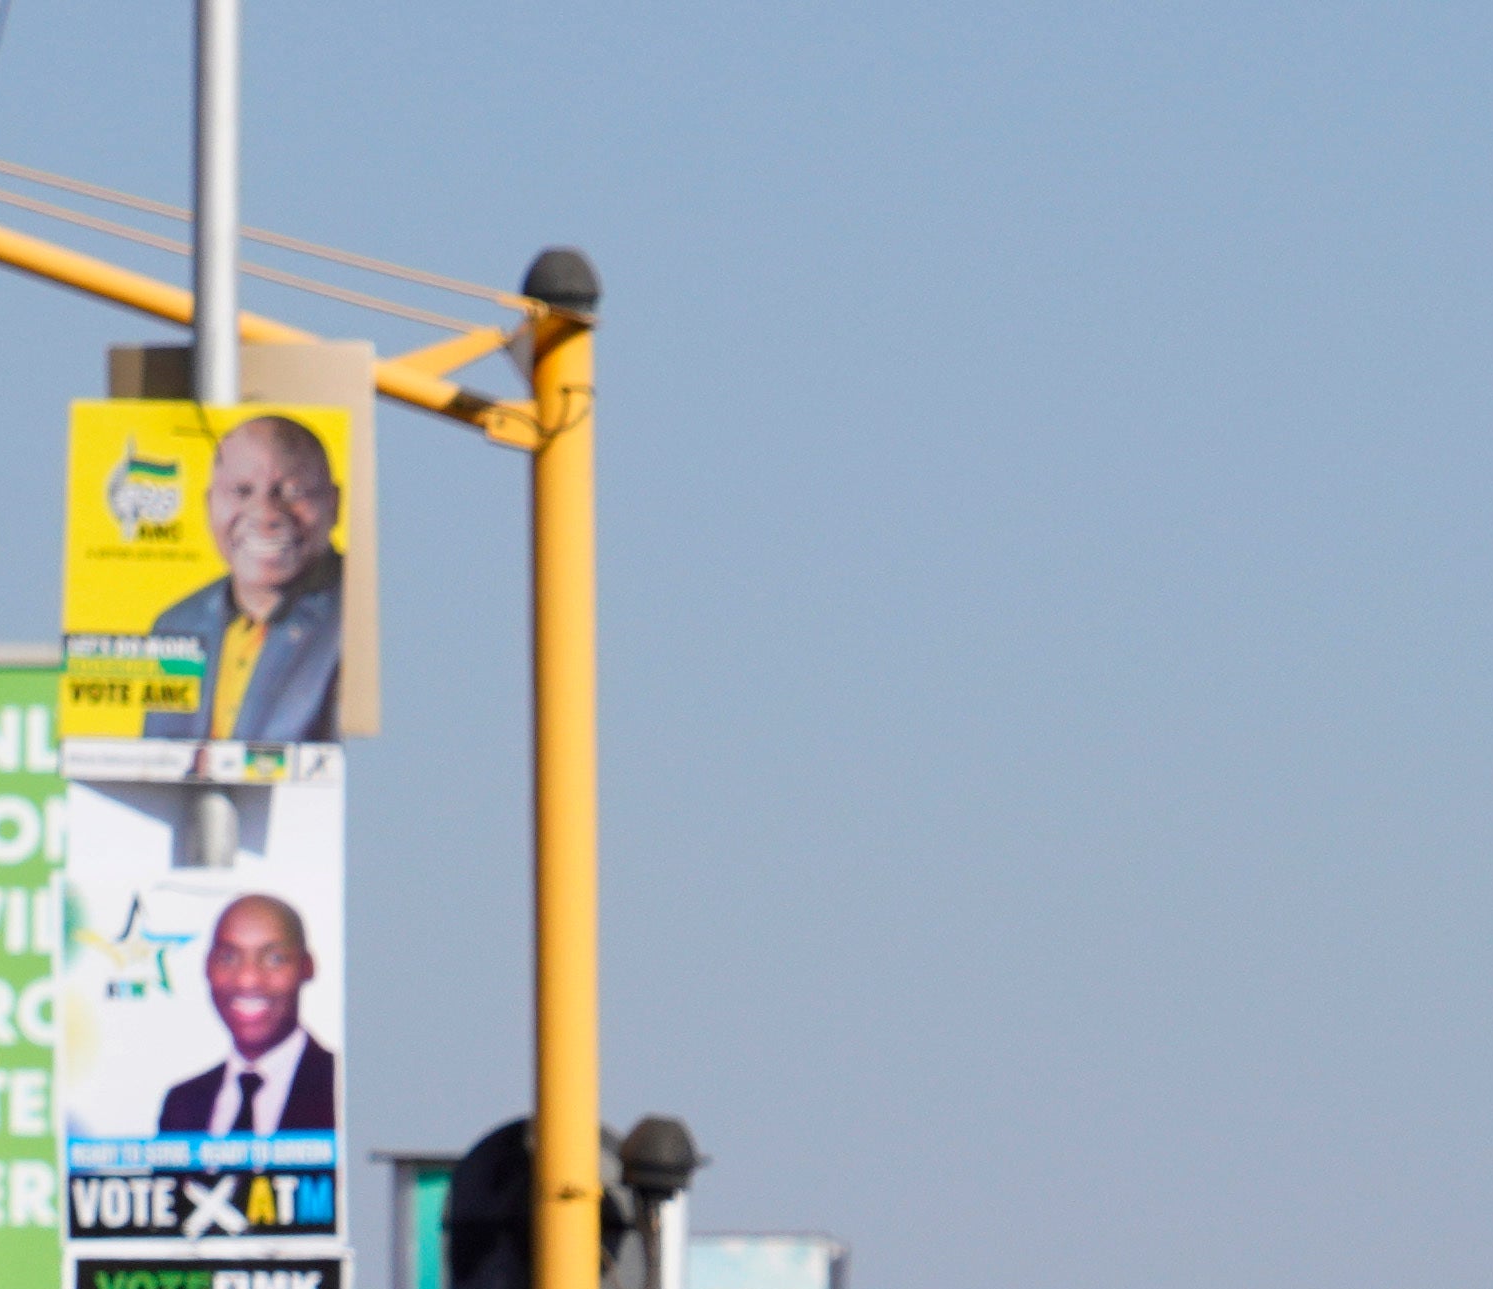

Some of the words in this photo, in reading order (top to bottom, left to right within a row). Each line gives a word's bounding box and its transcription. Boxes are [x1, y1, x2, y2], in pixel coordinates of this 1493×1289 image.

[69, 680, 131, 705] VOTE
[72, 1177, 177, 1229] VOTE
[246, 1175, 335, 1227] ATM
